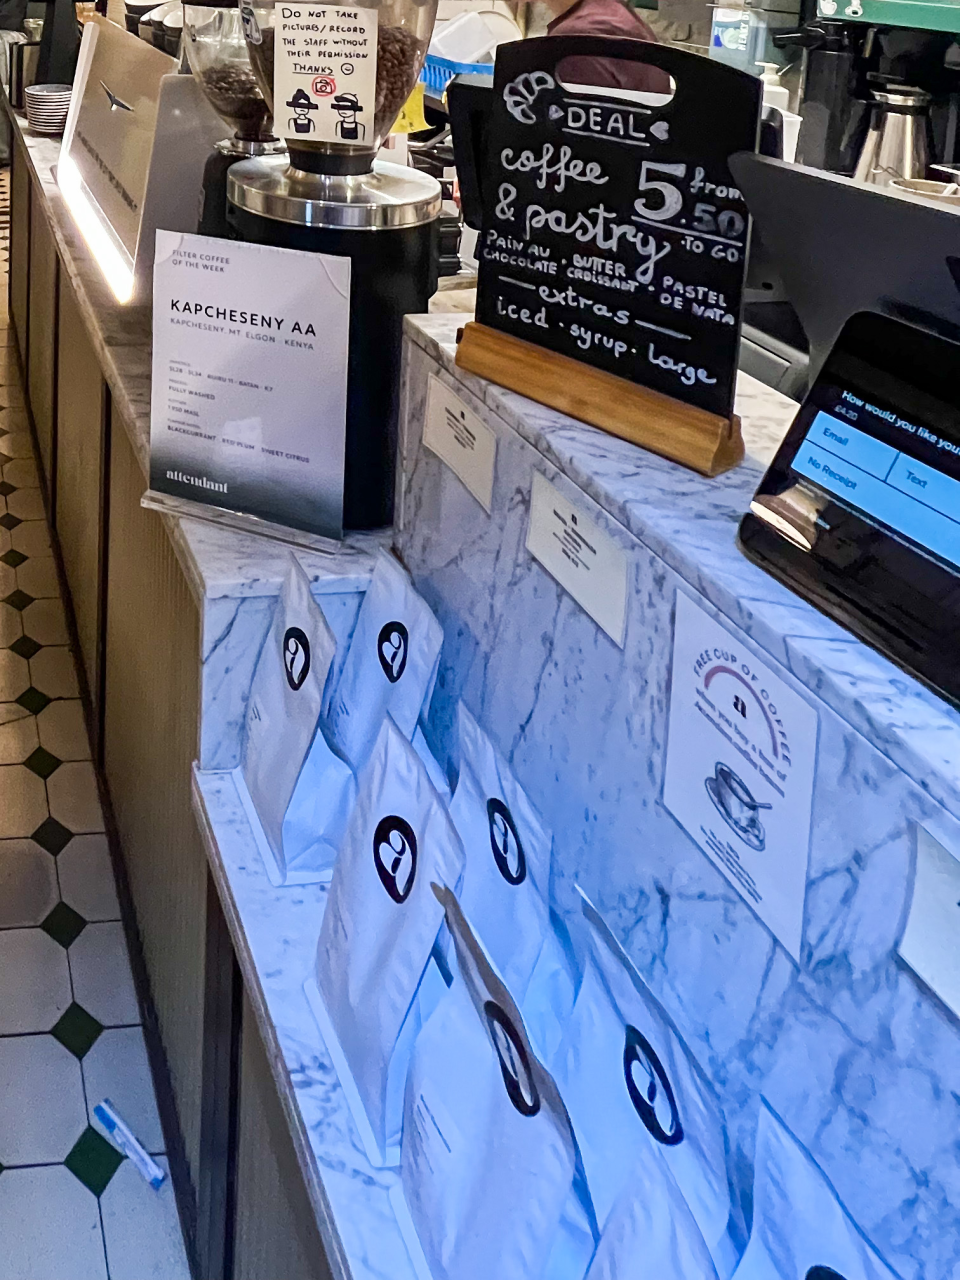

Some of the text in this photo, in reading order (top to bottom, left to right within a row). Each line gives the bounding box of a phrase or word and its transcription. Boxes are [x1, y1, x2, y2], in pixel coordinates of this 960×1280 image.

[308, 10, 327, 18] NOT
[335, 10, 358, 19] TAKE
[282, 38, 296, 46] THE
[304, 38, 328, 46] STAFF
[293, 63, 333, 74] THANKS
[567, 106, 645, 138] DEAL
[501, 143, 609, 193] coffee
[691, 167, 745, 201] from
[495, 182, 671, 284] & pastry
[172, 249, 230, 265] FILTER COFFEE
[483, 248, 558, 275] CHOCOLATE
[528, 245, 550, 258] AU
[711, 245, 739, 263] GO
[185, 260, 199, 269] THE
[202, 264, 225, 273] WEEK
[573, 253, 626, 278] BUTTER
[662, 276, 727, 307] PASTEL
[170, 298, 316, 337] KAPCHESENY AA
[539, 285, 630, 325] extras
[659, 293, 736, 326] DE NATA
[496, 296, 549, 329] iced
[570, 323, 629, 358] syrup
[245, 331, 276, 344] ELGON
[284, 339, 314, 351] KENYA
[168, 385, 216, 401] FULLY WASHED
[842, 390, 864, 407] How
[865, 402, 896, 423] would
[895, 417, 917, 433] you
[917, 426, 938, 443] like
[822, 427, 849, 446] Email
[166, 470, 228, 494] attendant
[808, 456, 857, 490] No Receipt
[905, 469, 928, 489] Text
[694, 648, 712, 677] FREE
[713, 648, 737, 663] CUP
